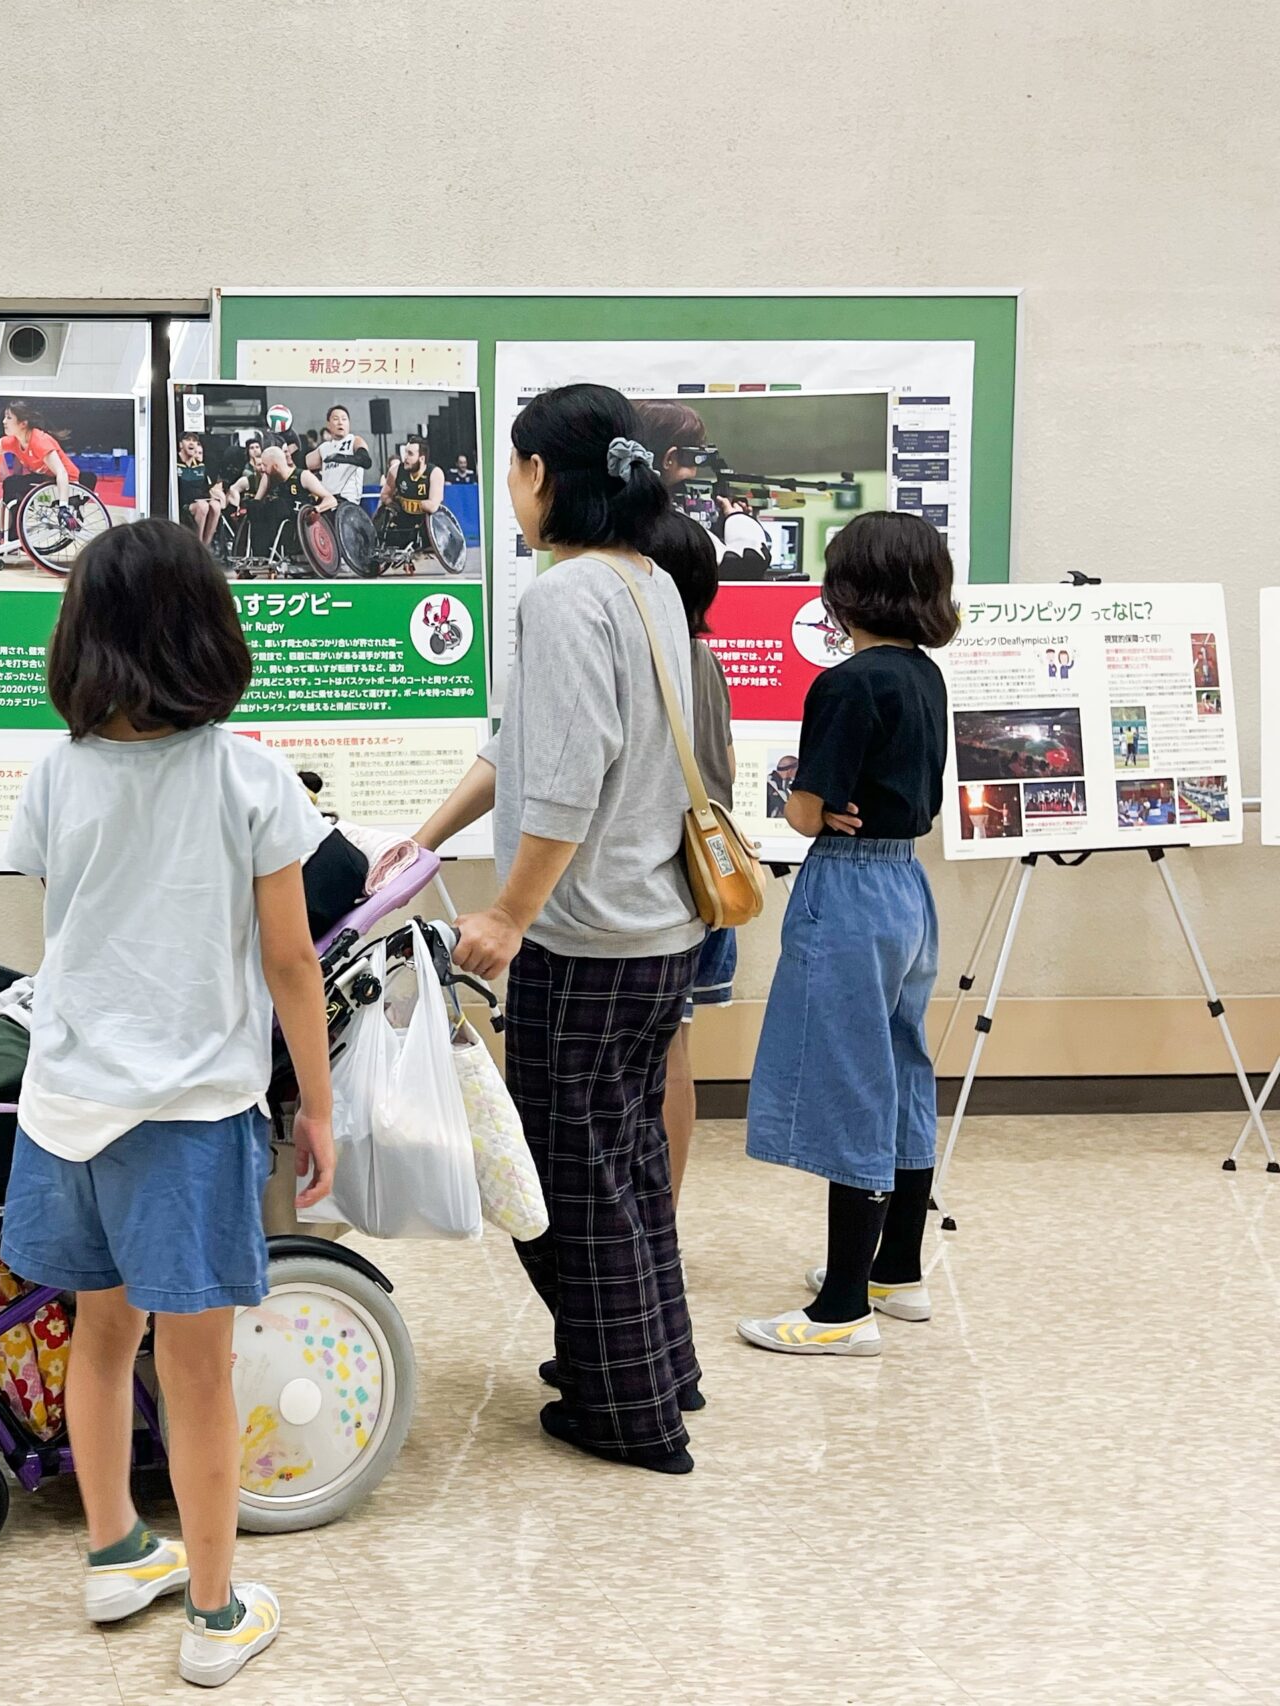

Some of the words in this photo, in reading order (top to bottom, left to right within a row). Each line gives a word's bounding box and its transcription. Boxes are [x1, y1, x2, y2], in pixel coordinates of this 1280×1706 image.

[290, 484, 297, 495] 6
[417, 483, 427, 496] 21
[968, 600, 1082, 623] デフリンピック
[255, 622, 285, 634] Rugby
